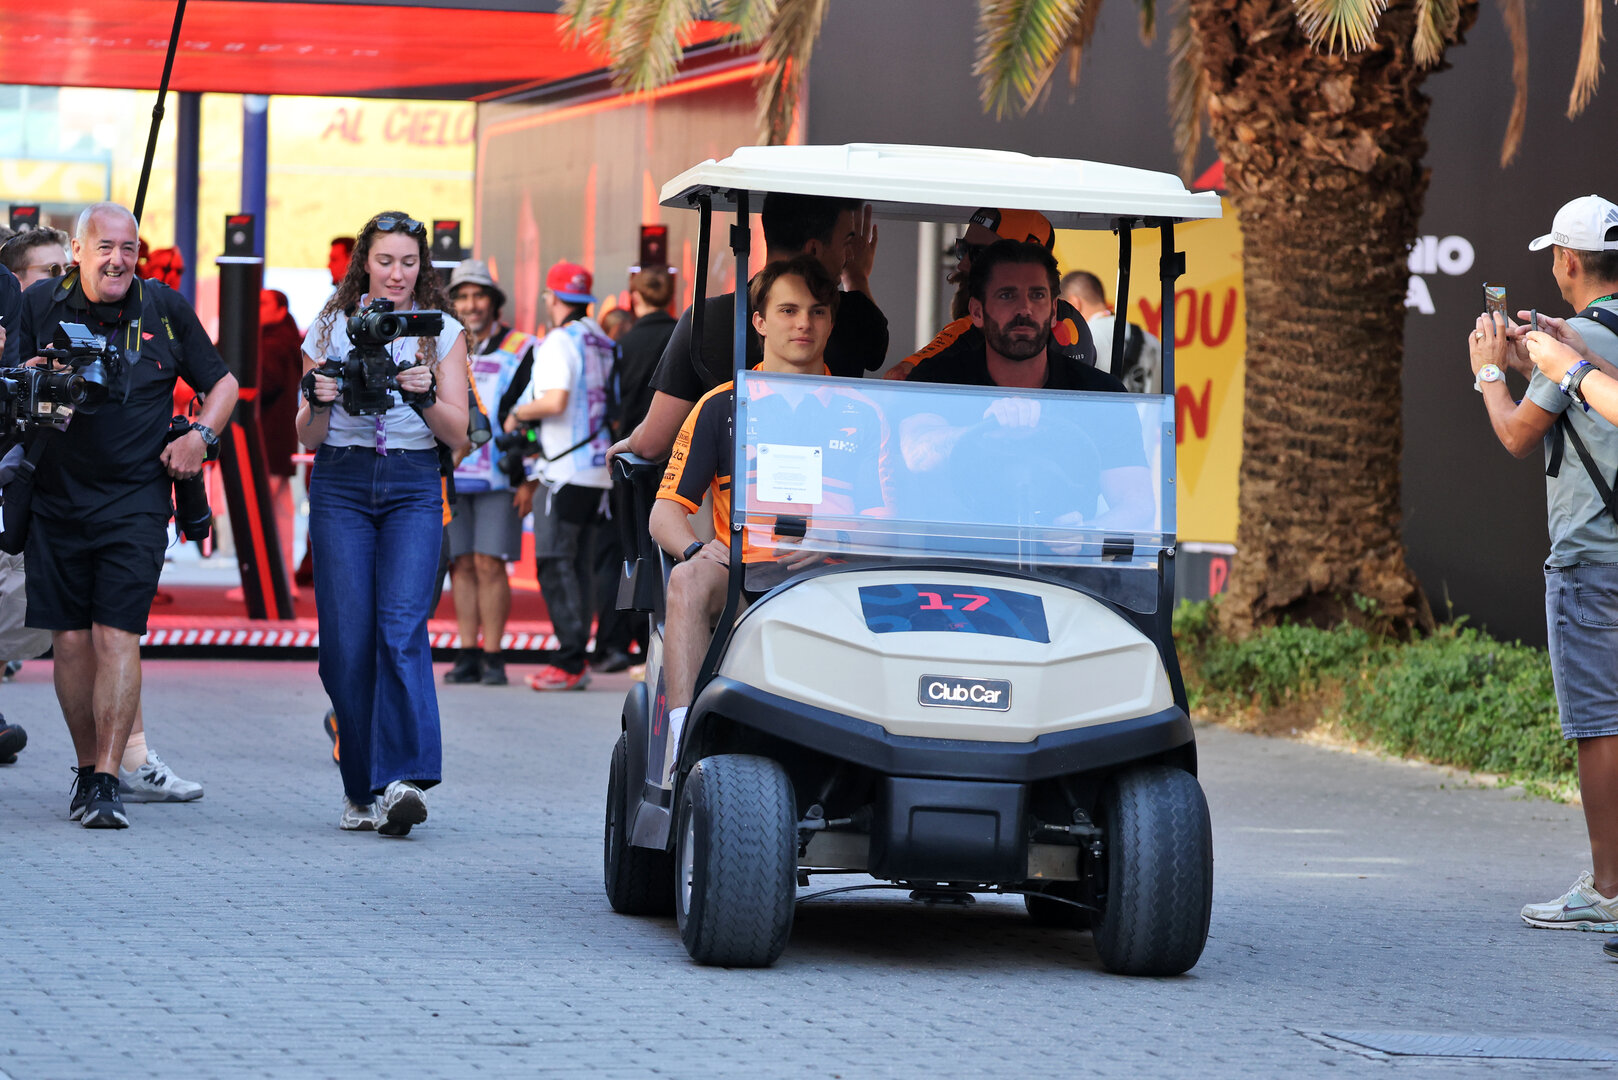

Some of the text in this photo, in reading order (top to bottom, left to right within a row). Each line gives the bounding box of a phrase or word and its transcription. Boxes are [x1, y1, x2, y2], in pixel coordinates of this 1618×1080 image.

[917, 591, 991, 612] 17
[928, 681, 1002, 704] Club Car
